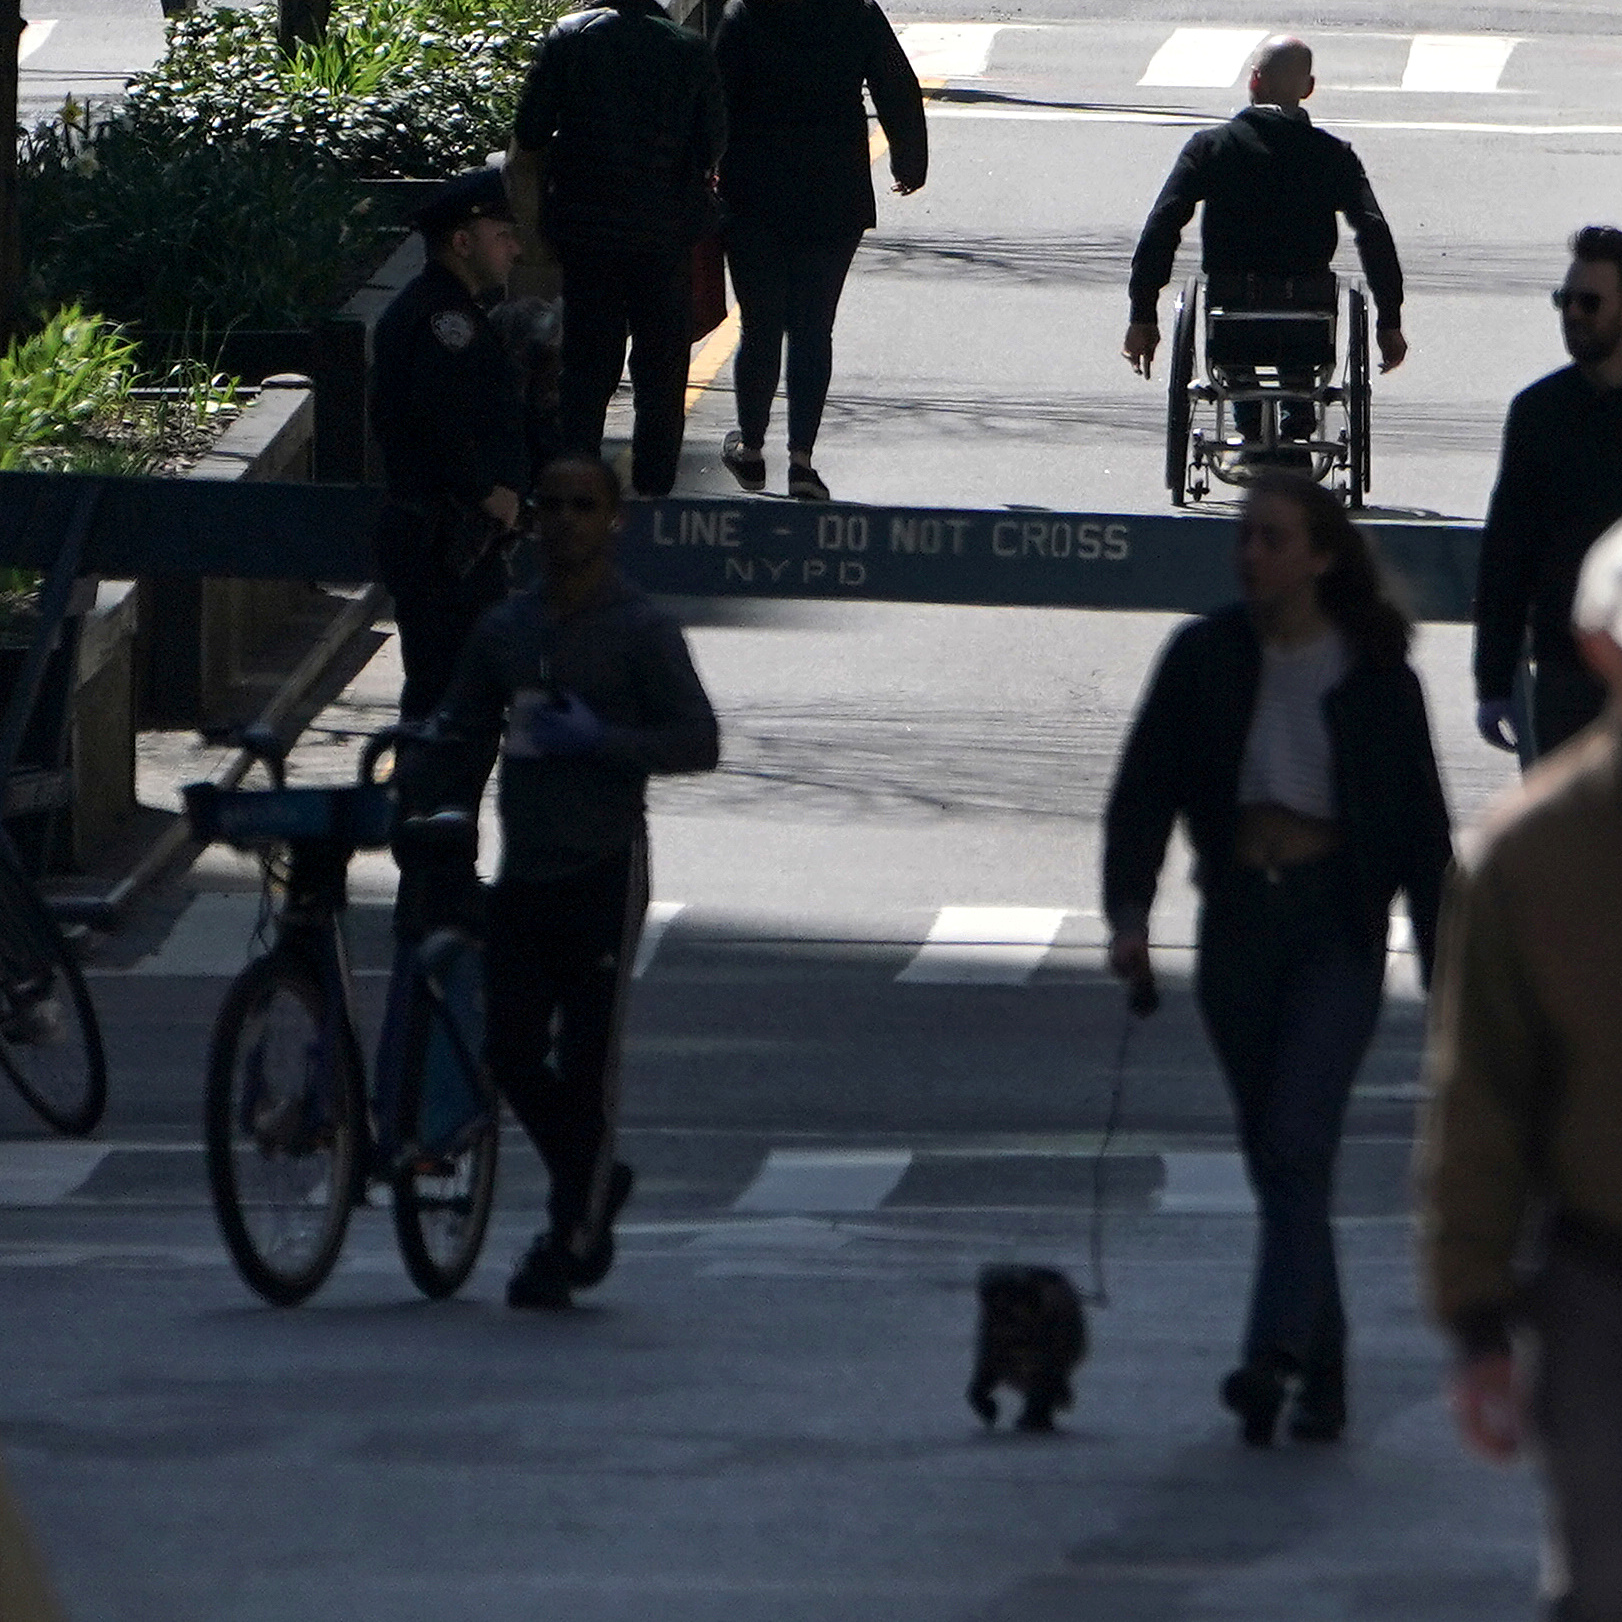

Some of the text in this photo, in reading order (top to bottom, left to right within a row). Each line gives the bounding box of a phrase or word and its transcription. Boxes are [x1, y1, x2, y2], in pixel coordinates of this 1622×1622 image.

[652, 510, 741, 549] LINE
[818, 514, 869, 551] DO
[890, 518, 969, 558] NOT
[991, 520, 1130, 562] CROSS
[725, 557, 868, 586] NYPD
